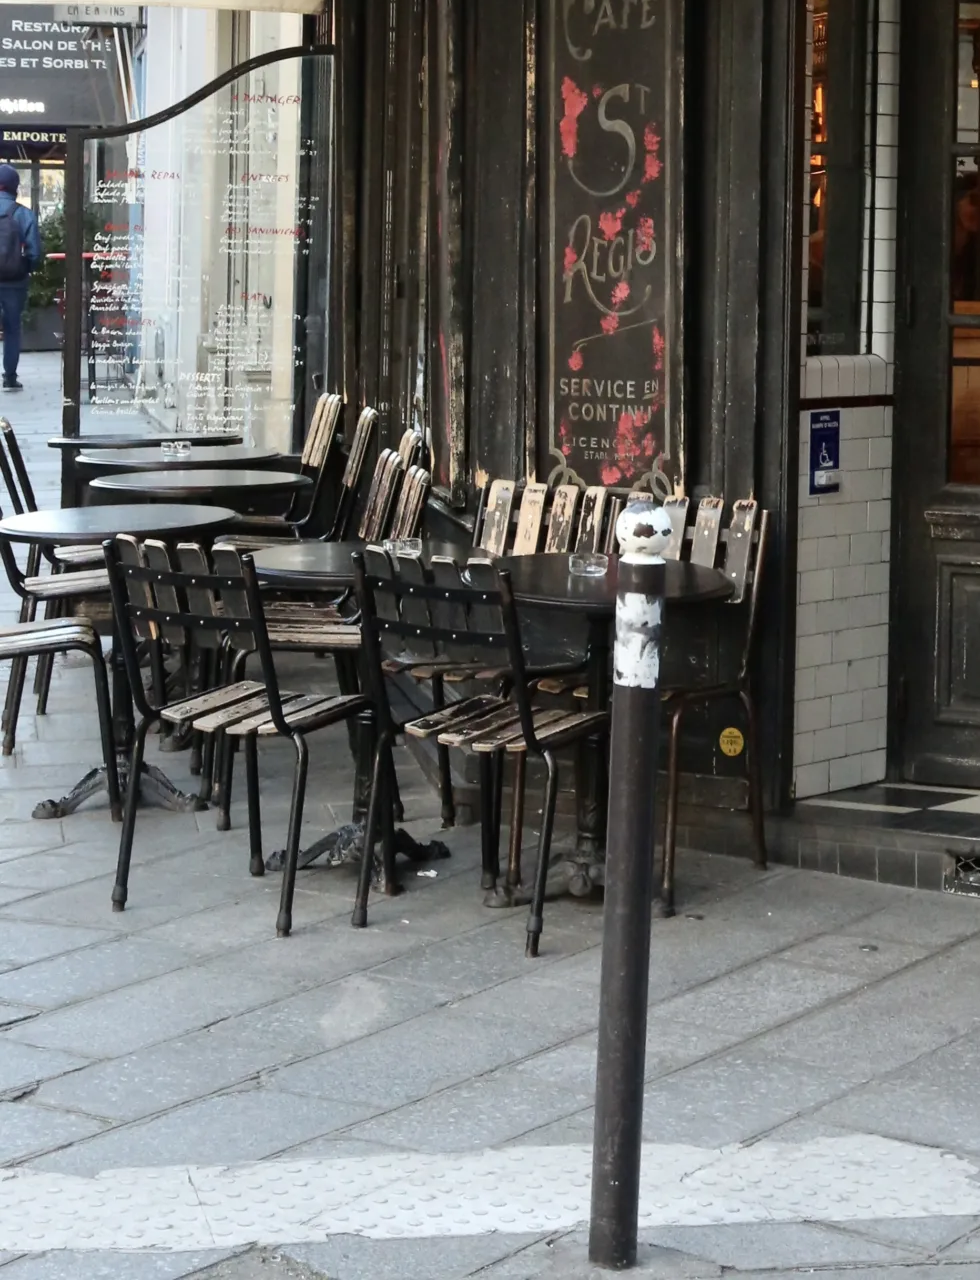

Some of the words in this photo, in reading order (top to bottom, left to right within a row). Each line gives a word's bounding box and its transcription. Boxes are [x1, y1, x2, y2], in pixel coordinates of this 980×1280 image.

[67, 5, 91, 16] CAE
[2, 38, 53, 51] SALON
[57, 41, 77, 51] DE
[20, 58, 39, 68] ET
[559, 377, 636, 399] SERVICE
[643, 378, 660, 397] EN
